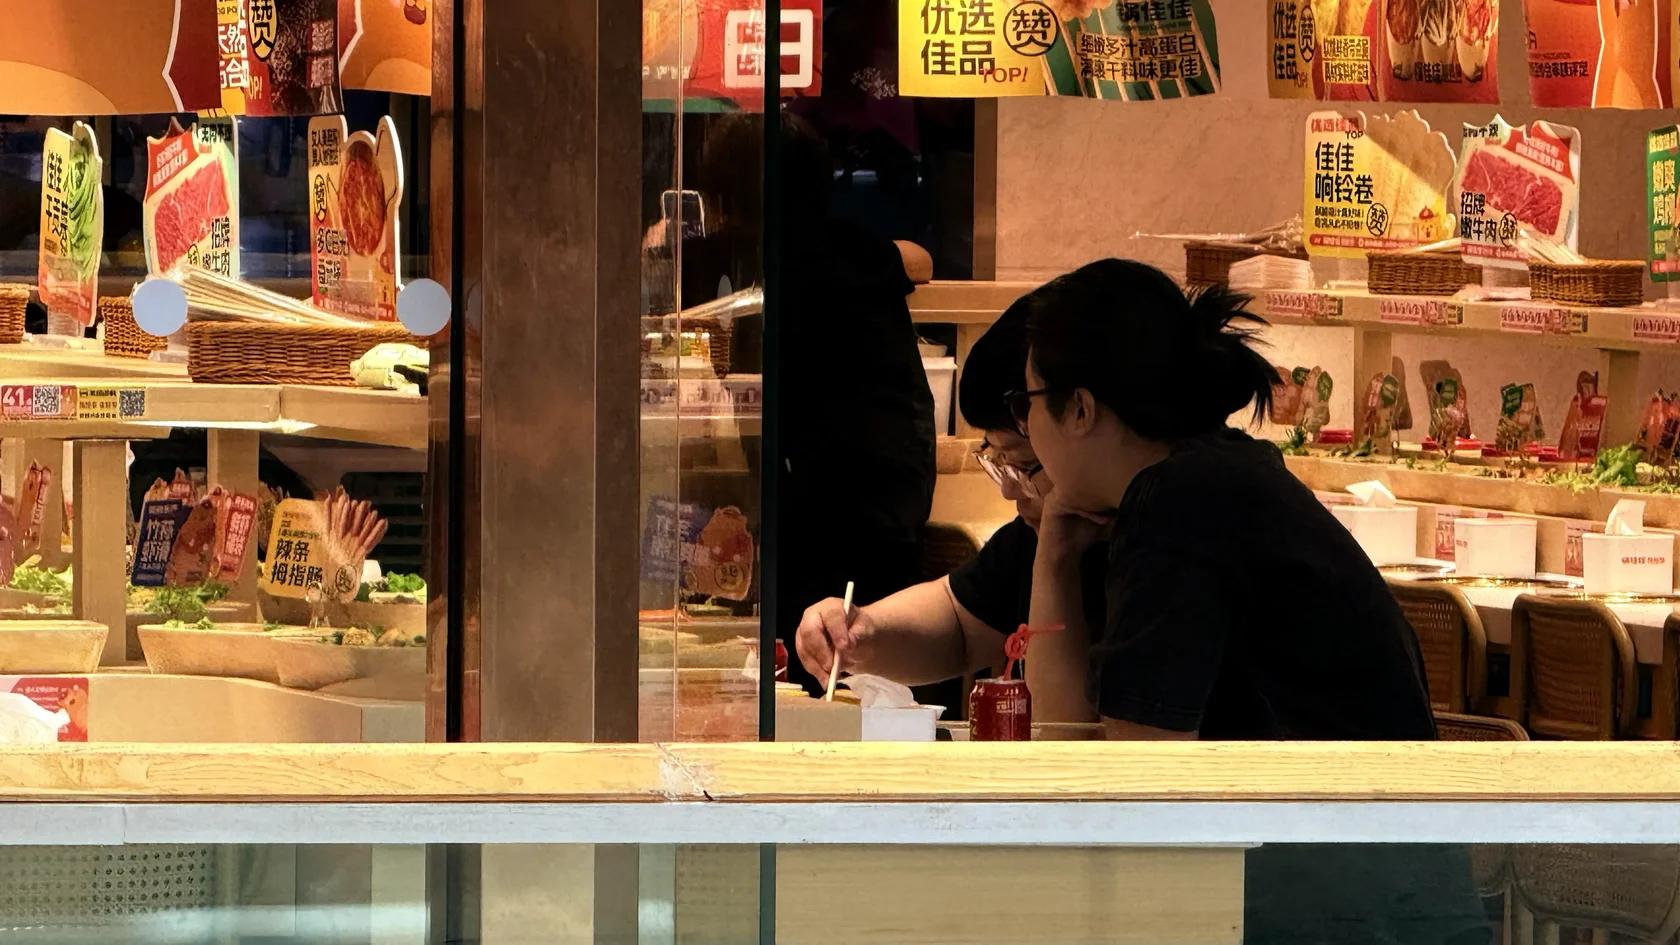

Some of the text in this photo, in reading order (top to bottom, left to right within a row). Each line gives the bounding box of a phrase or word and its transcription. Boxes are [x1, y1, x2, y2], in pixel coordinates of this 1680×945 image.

[921, 0, 995, 35] 优选
[1009, 8, 1053, 50] 赞
[1274, 0, 1296, 38] 优选
[921, 39, 996, 75] 佳品
[1274, 43, 1297, 79] 佳品
[980, 67, 1028, 83] TOP!
[1315, 141, 1354, 171] 佳佳
[1315, 173, 1373, 204] 响铃卷
[1461, 191, 1485, 215] 招牌
[1461, 216, 1497, 243] 嫩牛肉
[274, 538, 310, 563] 辣条
[270, 561, 323, 588] 拇指肠
